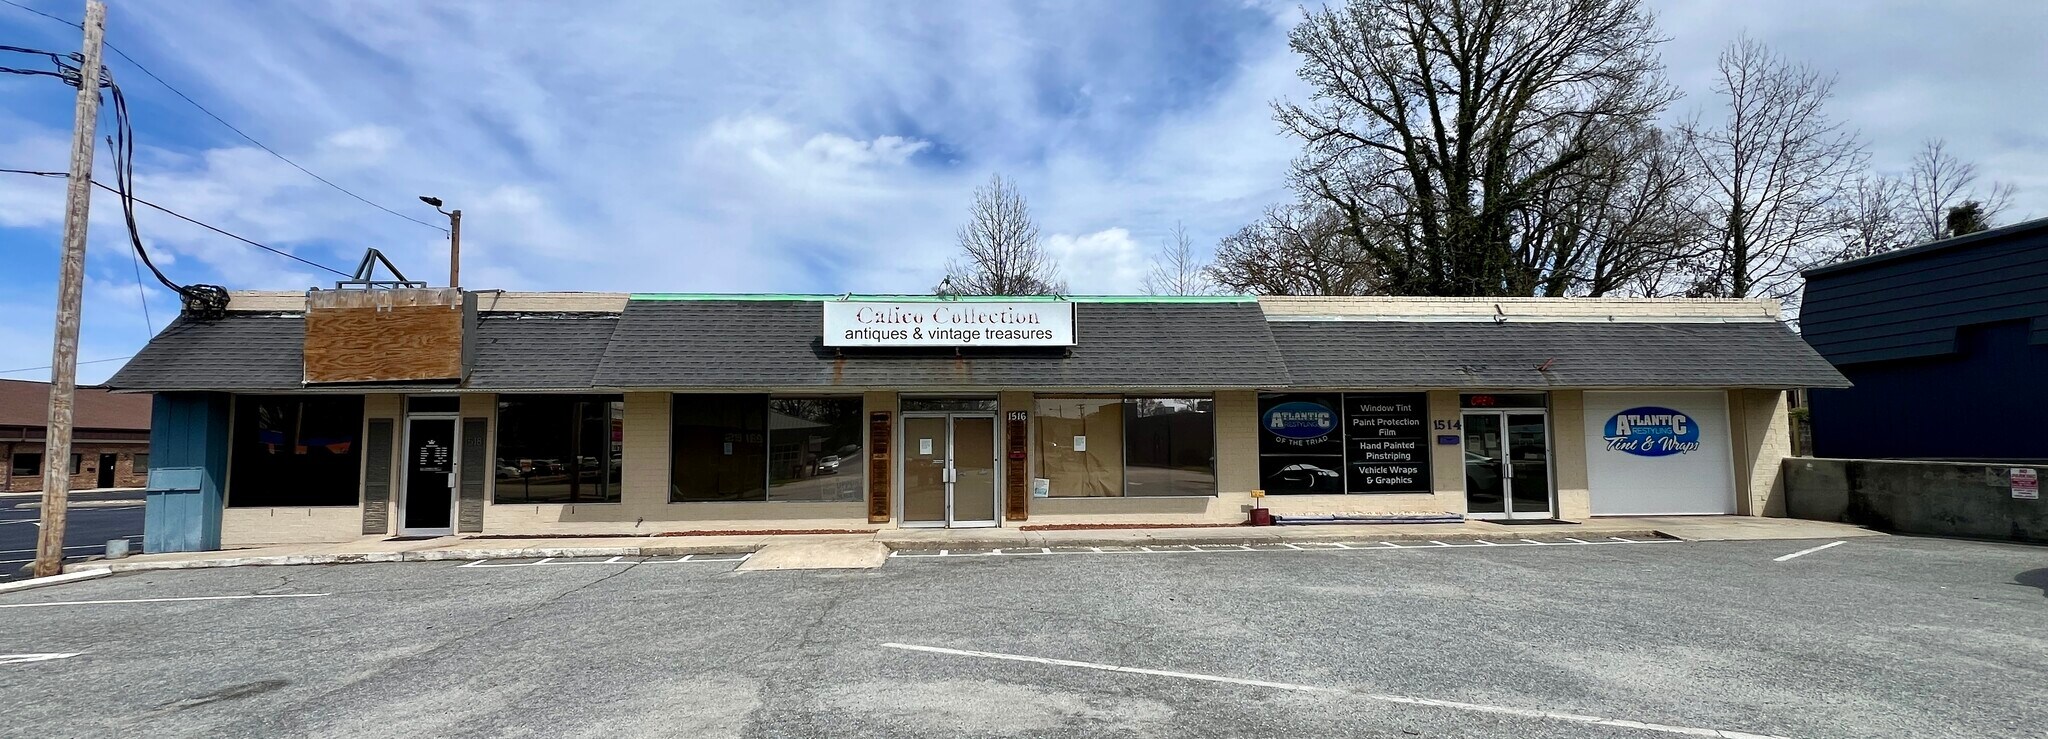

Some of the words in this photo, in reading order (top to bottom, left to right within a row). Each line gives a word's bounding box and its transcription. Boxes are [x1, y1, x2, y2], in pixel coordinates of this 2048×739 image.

[856, 306, 924, 324] Calico
[933, 306, 1040, 324] Collection
[845, 327, 908, 342] antiques
[912, 327, 923, 340] &
[928, 327, 981, 343] vintage
[985, 328, 1053, 340] treasures
[1360, 404, 1394, 412] Window
[1396, 404, 1412, 412] Tint
[1007, 412, 1027, 421] 1516
[1270, 411, 1330, 428] ATLANTIC
[1352, 418, 1375, 426] Paint
[1377, 418, 1420, 426] Protection
[1433, 419, 1462, 430] 1514
[1616, 414, 1687, 436] ATLANTIC
[1378, 428, 1396, 436] Film
[1632, 427, 1673, 435] RESTYLING
[1275, 436, 1286, 444] OF
[1289, 439, 1303, 447] THE
[1305, 435, 1329, 446] TRIAD
[1360, 442, 1382, 450] Hand
[1383, 441, 1415, 449] Painted
[1603, 436, 1638, 451] Tint
[1641, 436, 1655, 452] &
[1658, 435, 1700, 454] Wraps
[1366, 452, 1411, 461] Pinstriping
[1358, 466, 1388, 474] Vehicle
[1389, 466, 1418, 475] Wraps
[1366, 476, 1374, 484] &
[1375, 476, 1413, 485] Graphics
